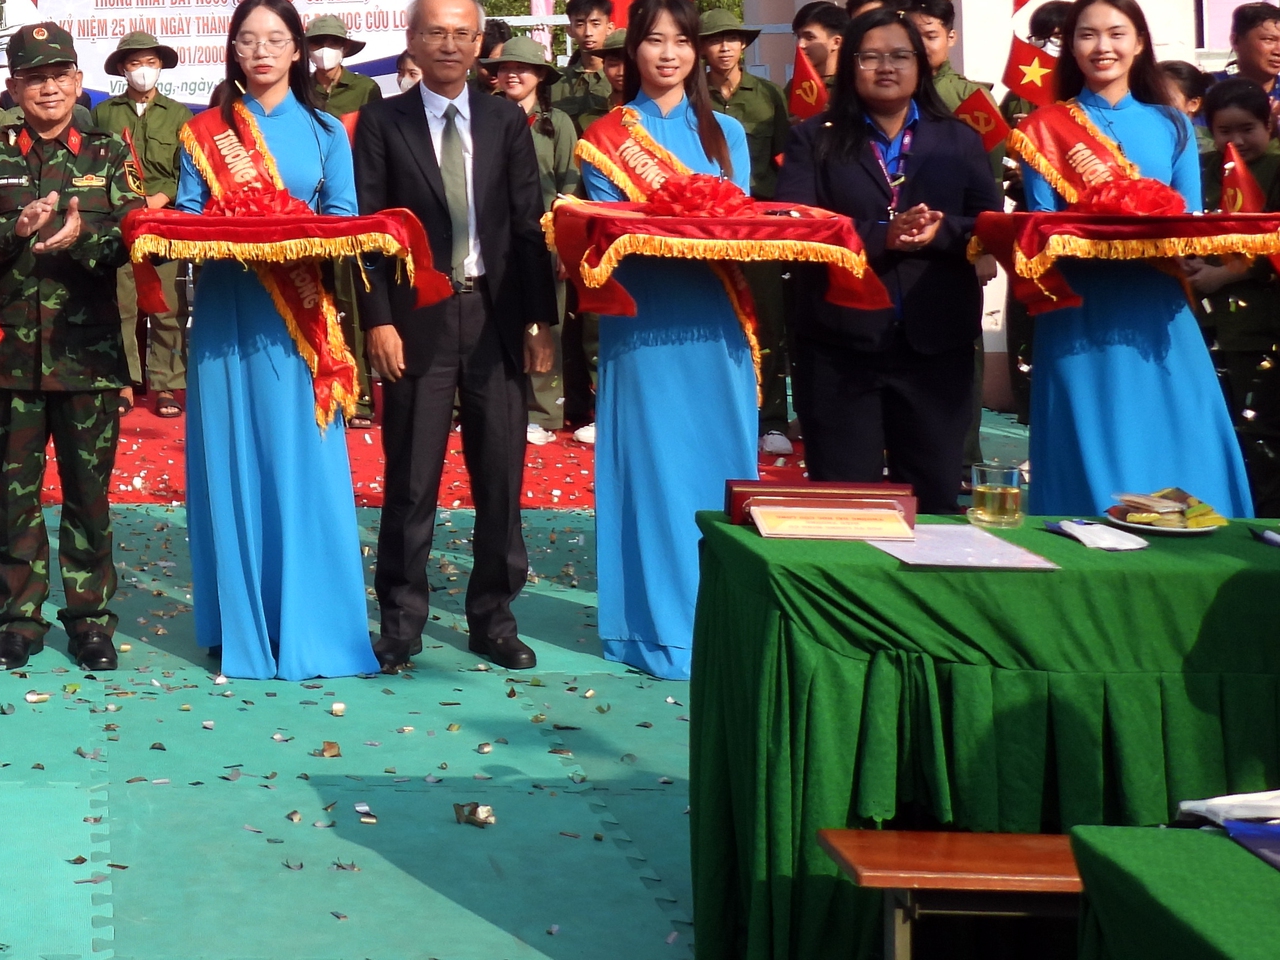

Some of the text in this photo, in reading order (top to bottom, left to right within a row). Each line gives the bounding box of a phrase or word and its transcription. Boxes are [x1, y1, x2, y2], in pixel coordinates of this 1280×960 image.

[77, 15, 108, 41] NIỆM
[110, 17, 126, 37] 25
[128, 13, 157, 36] NĂM
[160, 12, 192, 36] NGÀY
[365, 5, 389, 30] CỬU
[180, 77, 214, 96] ngày
[213, 128, 259, 184] TRƯỜNG
